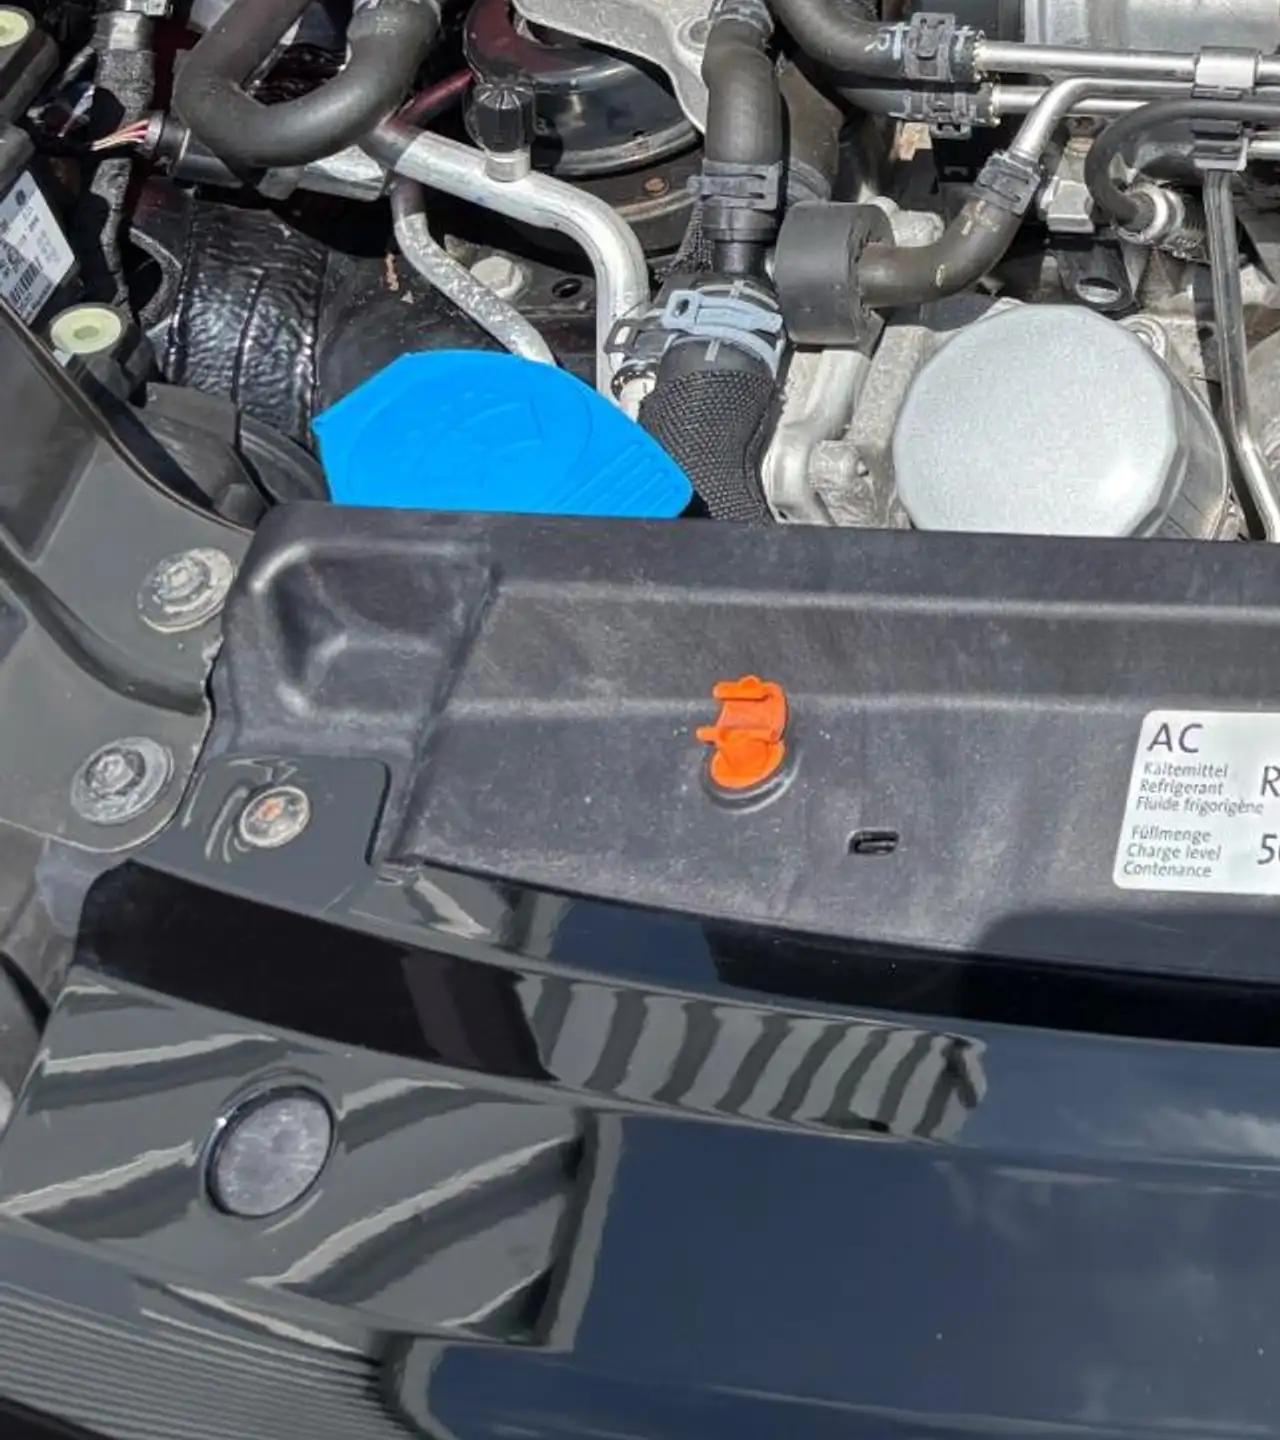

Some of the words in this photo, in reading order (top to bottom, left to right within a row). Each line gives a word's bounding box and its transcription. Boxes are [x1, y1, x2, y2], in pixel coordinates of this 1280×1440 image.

[1146, 723, 1203, 753] AC
[1143, 761, 1228, 777] Kältemittel
[1139, 778, 1224, 796] Refrigerant
[1136, 796, 1180, 812] Fluide
[1183, 798, 1264, 817] frigorigène
[1131, 825, 1212, 843] Füllmenge
[1126, 842, 1181, 861] Charge
[1185, 844, 1222, 860] level
[1123, 861, 1212, 878] Contenance
